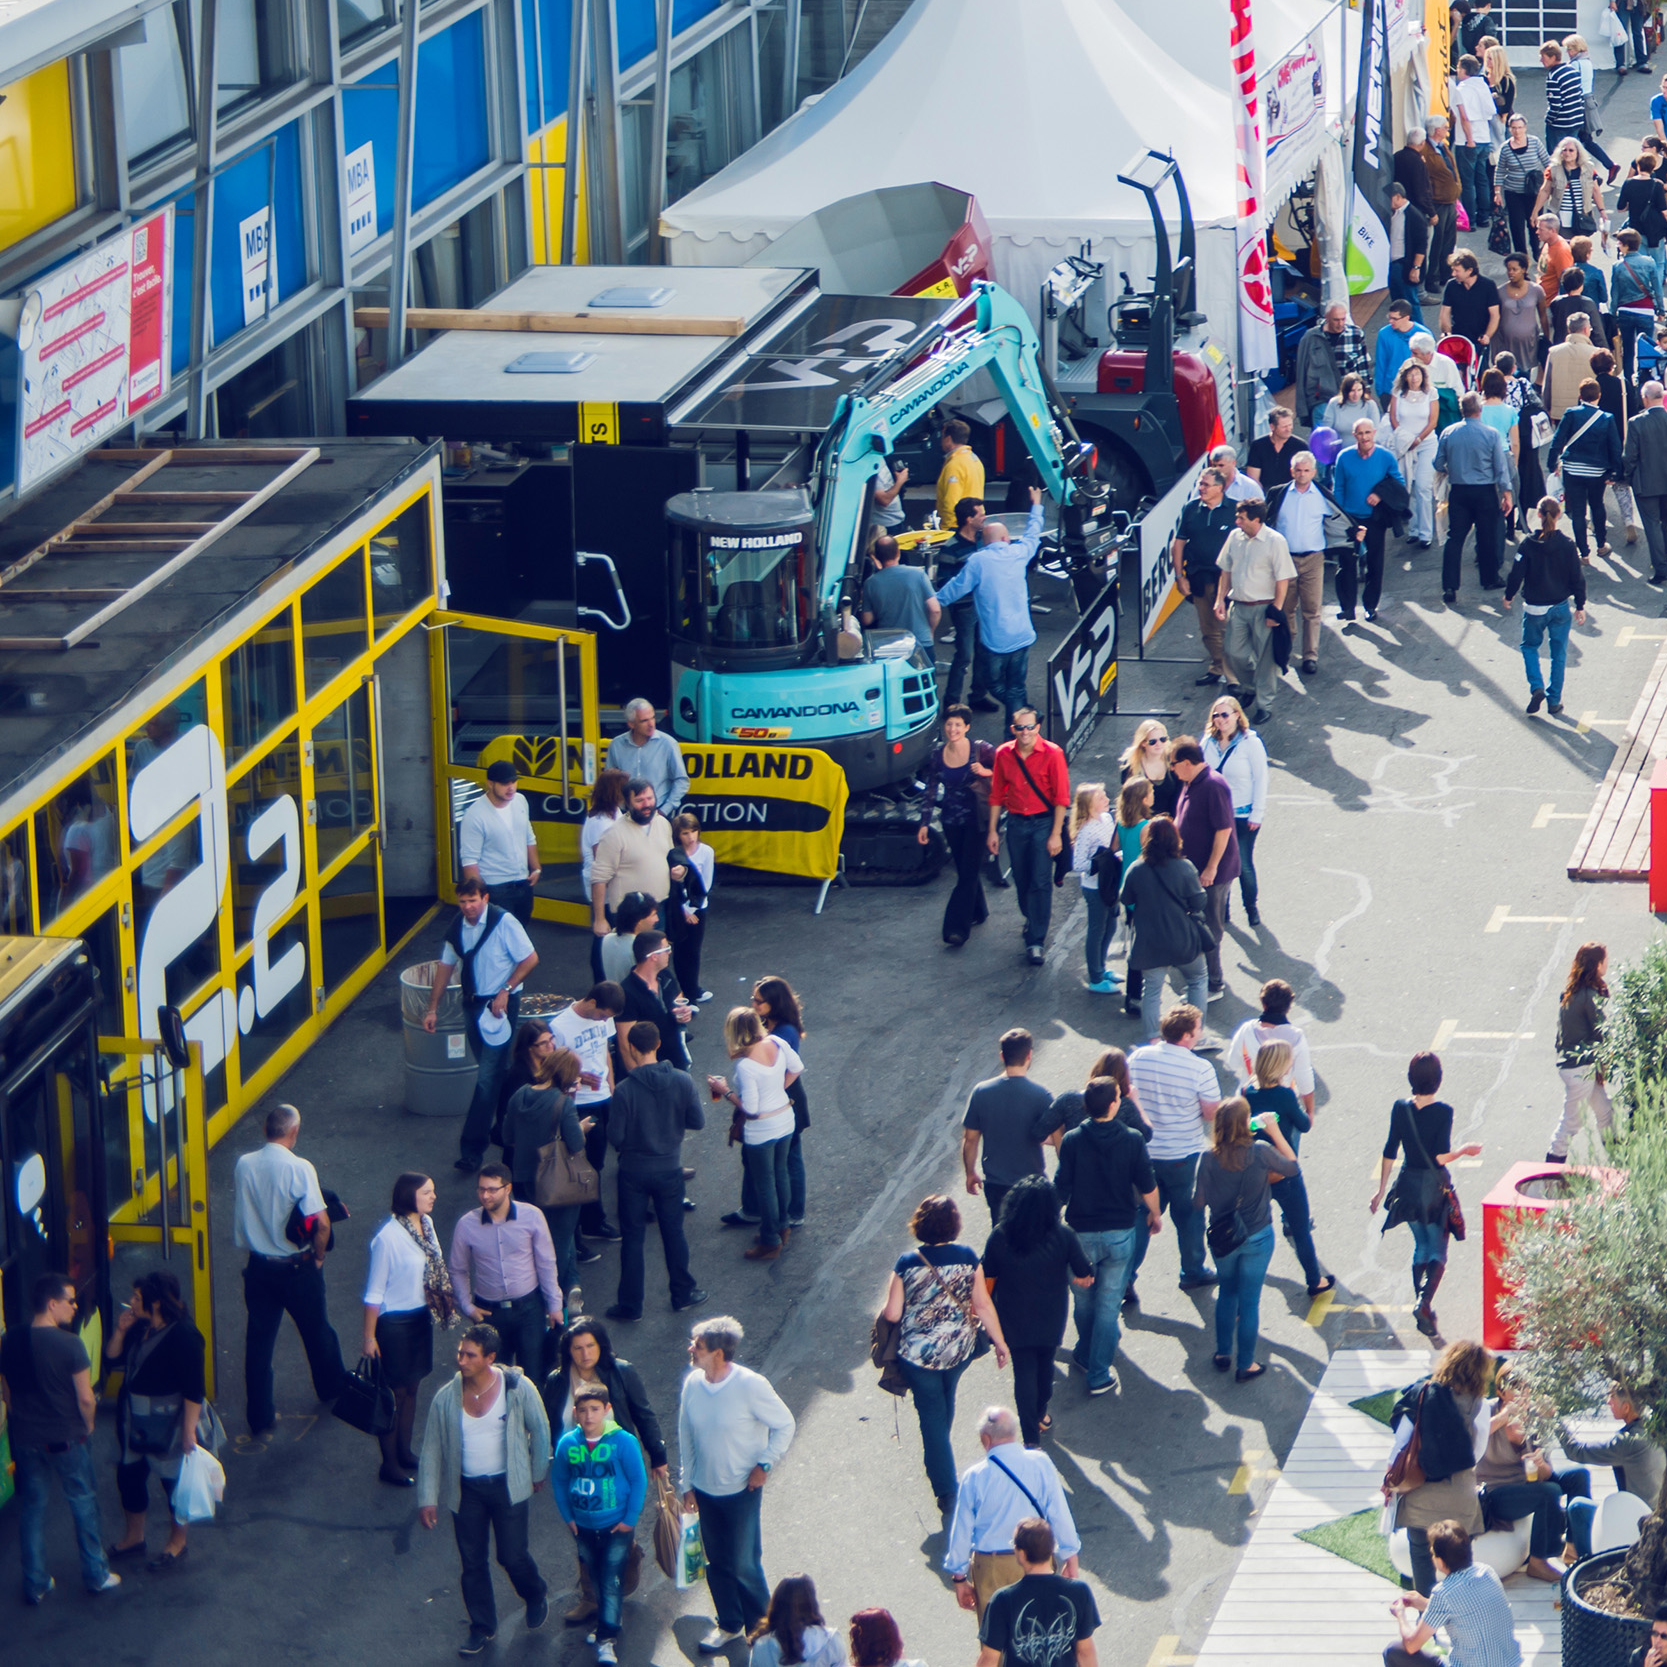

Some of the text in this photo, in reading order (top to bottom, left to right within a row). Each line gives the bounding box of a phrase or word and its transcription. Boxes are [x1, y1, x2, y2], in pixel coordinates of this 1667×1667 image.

[347, 158, 370, 195] MBA
[1358, 226, 1376, 251] BIKE
[889, 359, 971, 427] CAMANDONA
[710, 532, 804, 550] NEW HOLLAND
[730, 700, 860, 720] CAMANDONA
